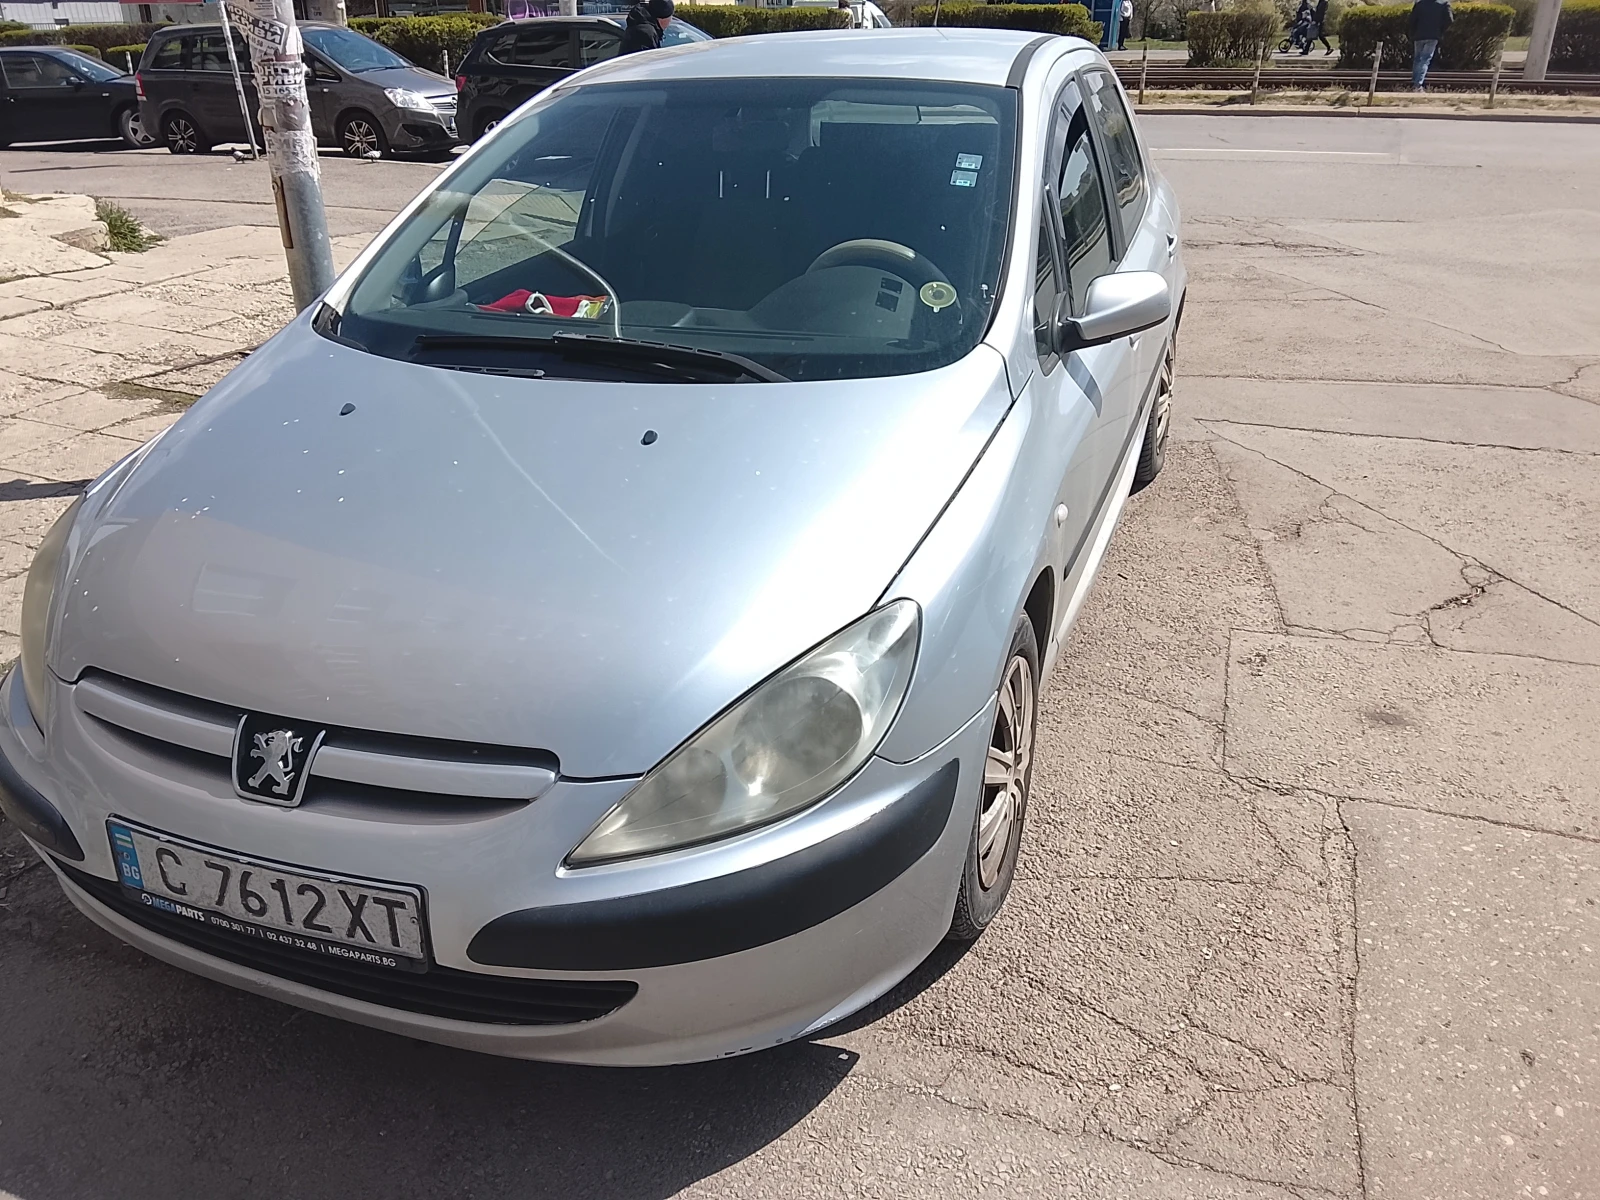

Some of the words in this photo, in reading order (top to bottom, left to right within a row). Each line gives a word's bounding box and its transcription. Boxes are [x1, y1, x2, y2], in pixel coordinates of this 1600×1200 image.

[258, 20, 282, 35] НА
[122, 862, 140, 880] BG
[156, 847, 188, 895] C
[205, 859, 333, 934] 7612
[337, 889, 408, 948] XT
[151, 896, 205, 922] MEGAPARTS
[210, 915, 230, 928] 0700
[231, 921, 245, 933] 301
[246, 925, 256, 935] 77
[266, 932, 278, 941] 02
[278, 933, 293, 944] 437
[294, 938, 306, 948] 32
[307, 941, 318, 950] 48
[328, 946, 397, 967] MEGAPARTS.BG
